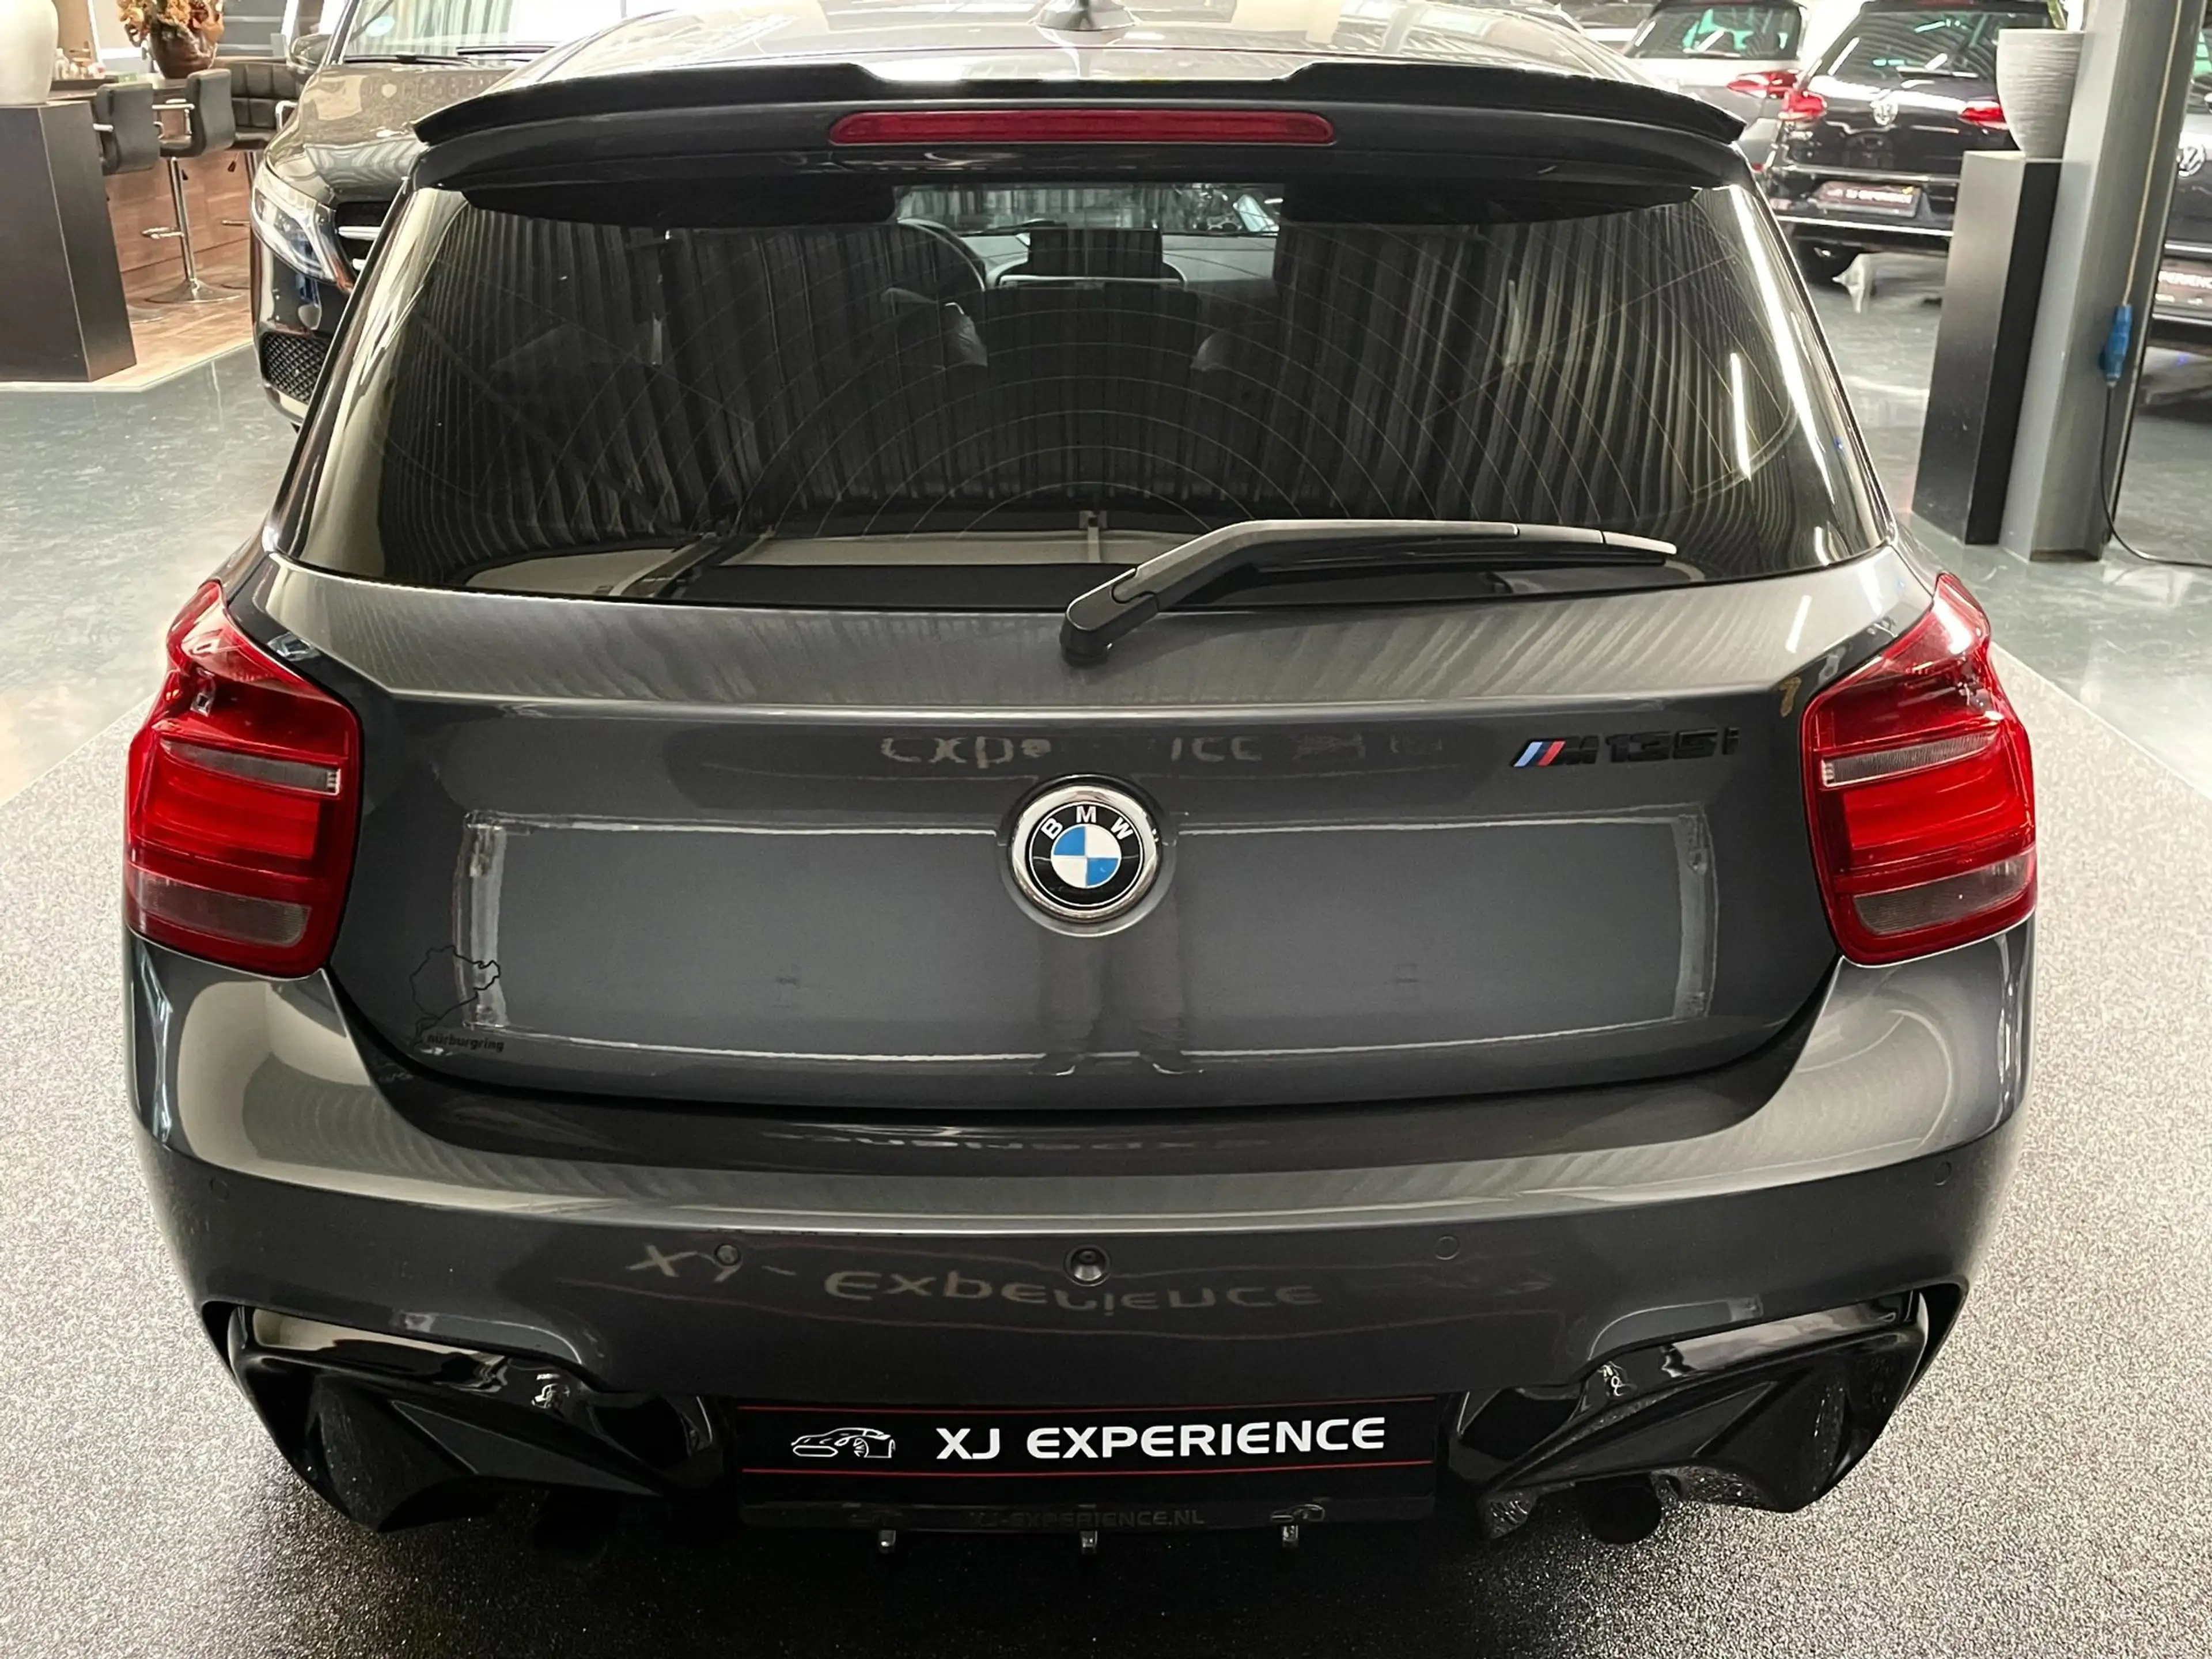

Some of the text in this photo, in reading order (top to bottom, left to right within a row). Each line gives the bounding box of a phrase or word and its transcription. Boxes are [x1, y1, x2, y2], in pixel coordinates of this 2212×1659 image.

[1040, 806, 1134, 840] BMW
[935, 1416, 1385, 1460] XJ EXPERIENCE
